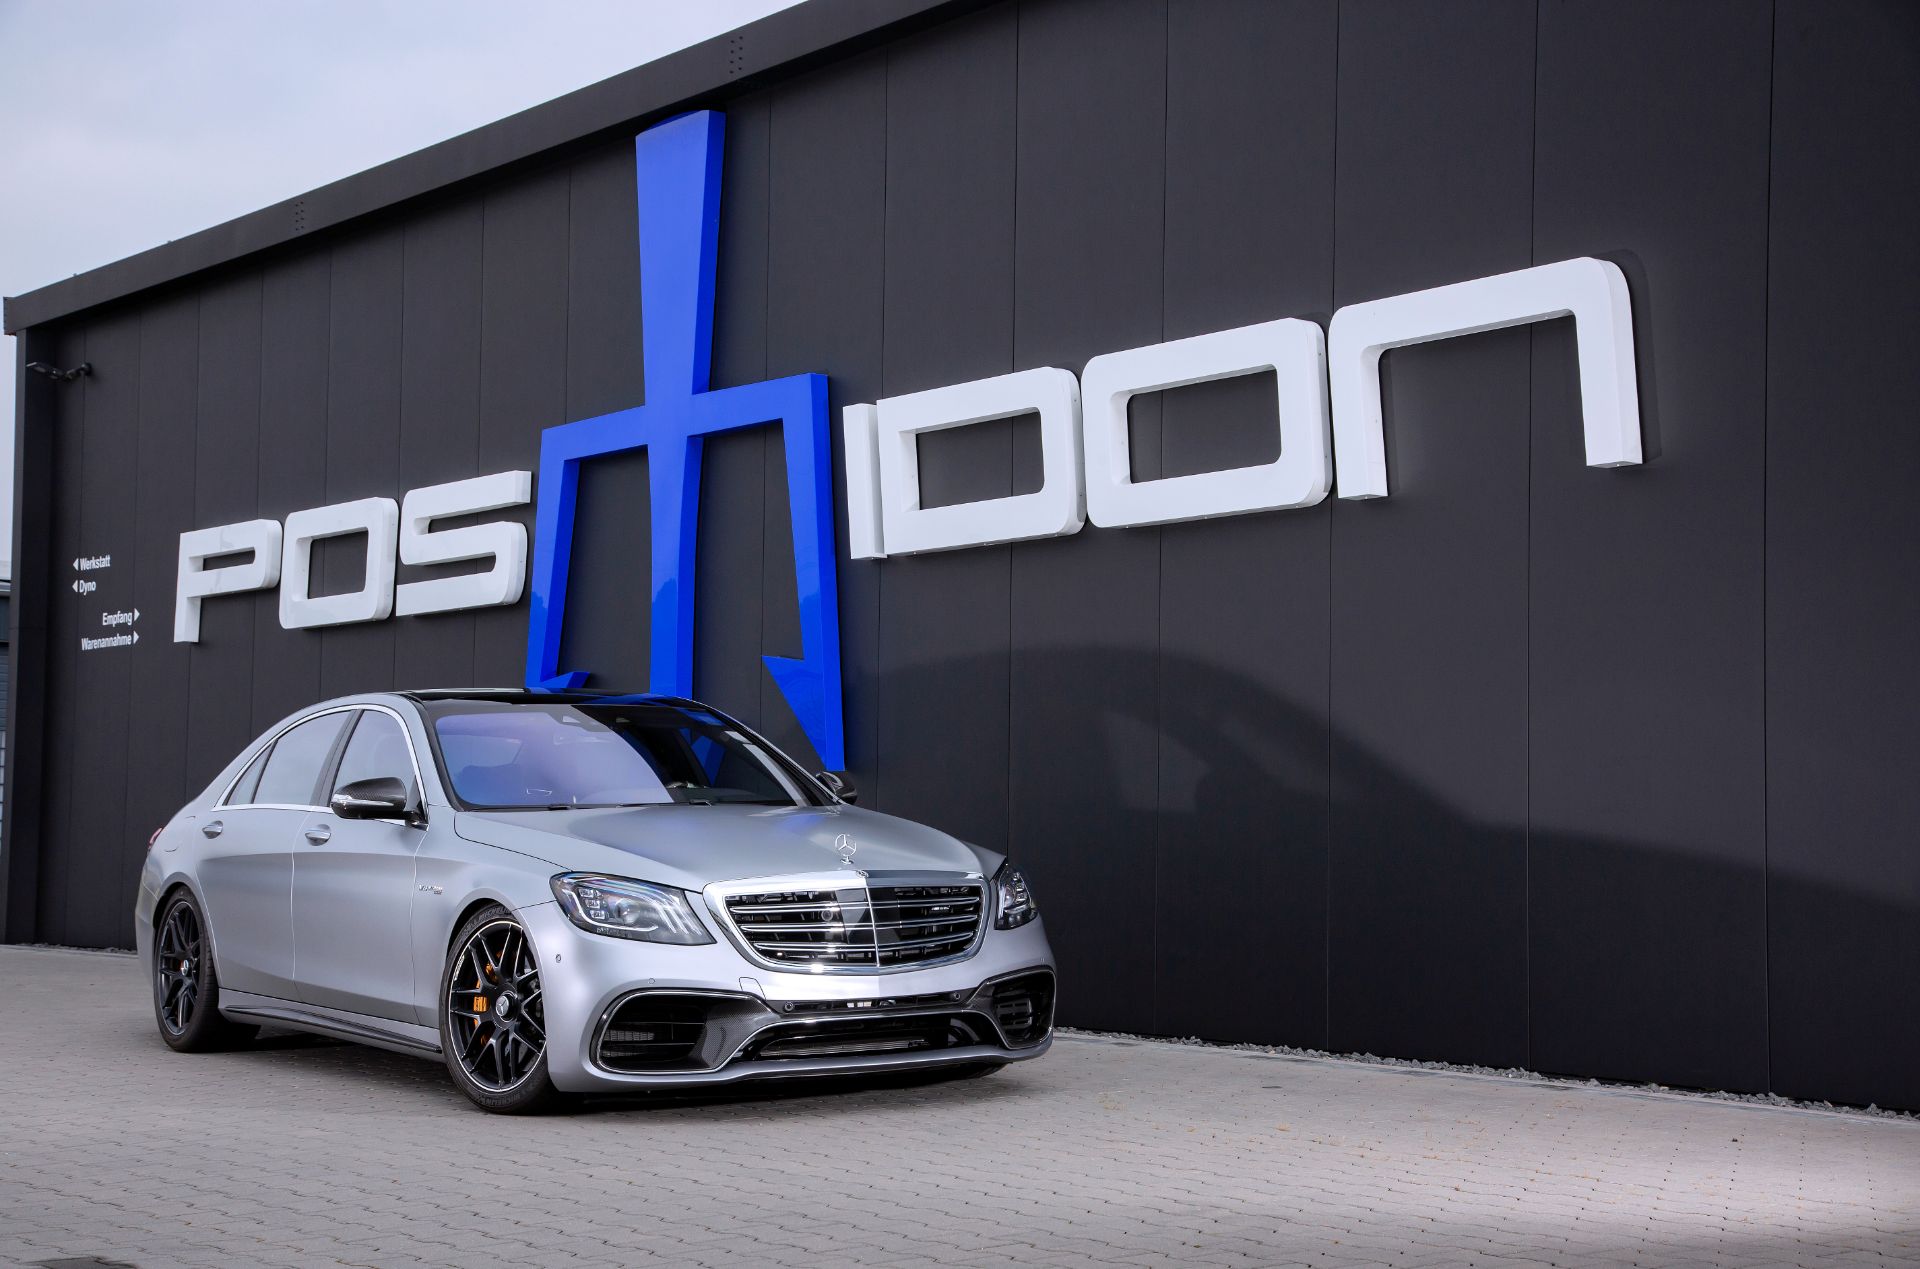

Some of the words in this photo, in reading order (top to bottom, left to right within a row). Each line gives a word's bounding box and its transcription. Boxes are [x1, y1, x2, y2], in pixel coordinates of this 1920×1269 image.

[79, 555, 111, 571] Werkstatt
[79, 580, 96, 595] Dyno
[102, 610, 133, 627] Empfang
[81, 633, 132, 651] Warenannahme
